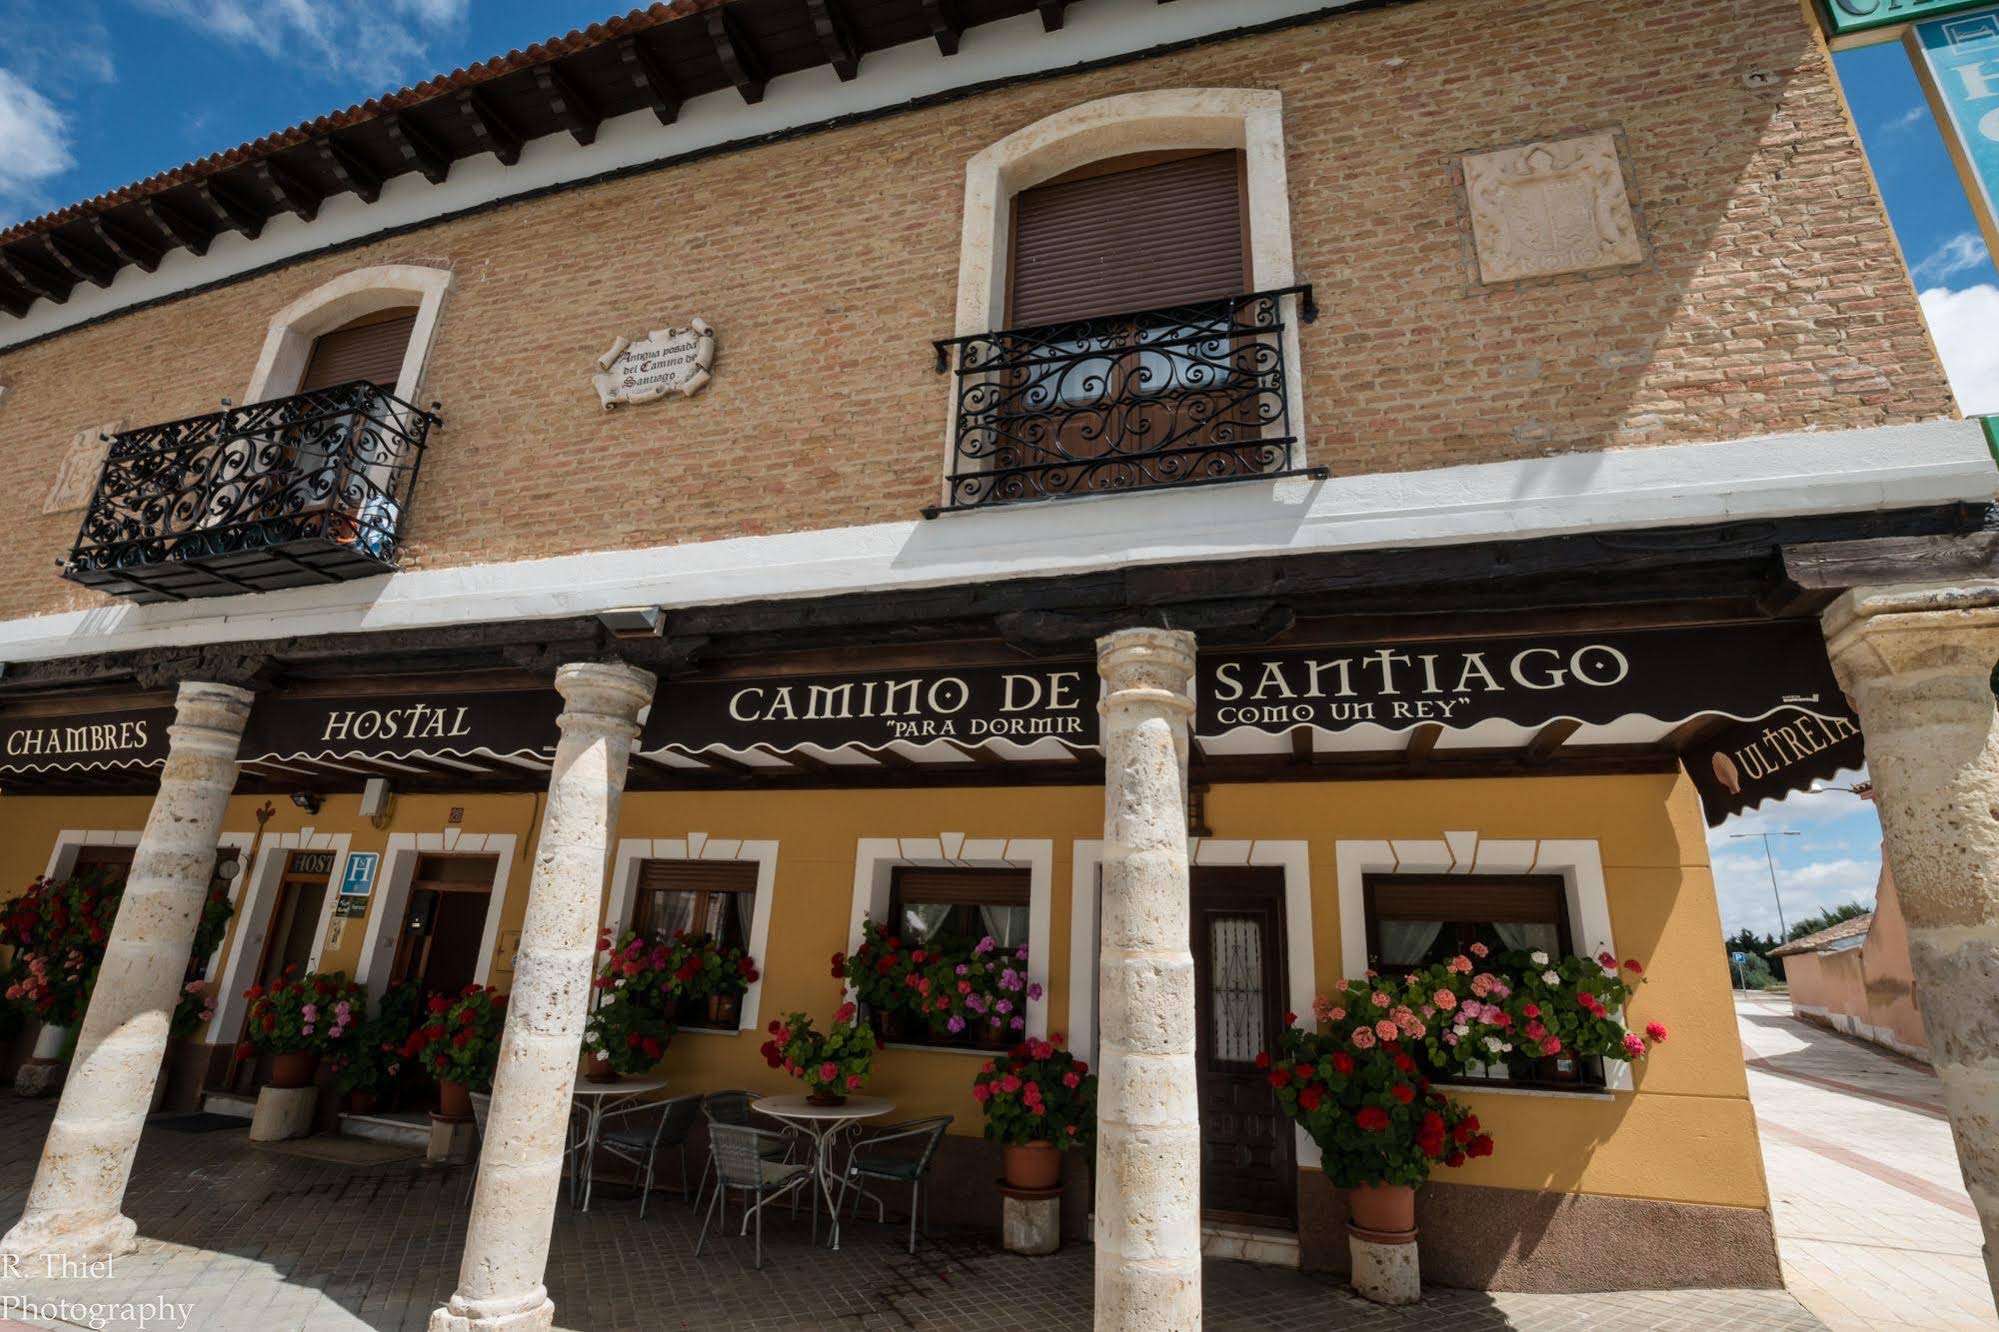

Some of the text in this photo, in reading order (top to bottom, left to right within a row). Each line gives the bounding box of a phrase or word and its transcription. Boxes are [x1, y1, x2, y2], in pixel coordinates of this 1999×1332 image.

[620, 341, 697, 363] Antigua posada
[623, 353, 698, 375] del Camino de
[621, 372, 676, 388] Santiago
[730, 644, 1629, 722] CAMINO DE SANTIAGO
[321, 703, 471, 741] HOSTAL
[970, 717, 1084, 735] DORMIR
[1217, 704, 1316, 724] COMO
[1330, 702, 1374, 720] UN
[7, 720, 148, 756] CHAMBRES
